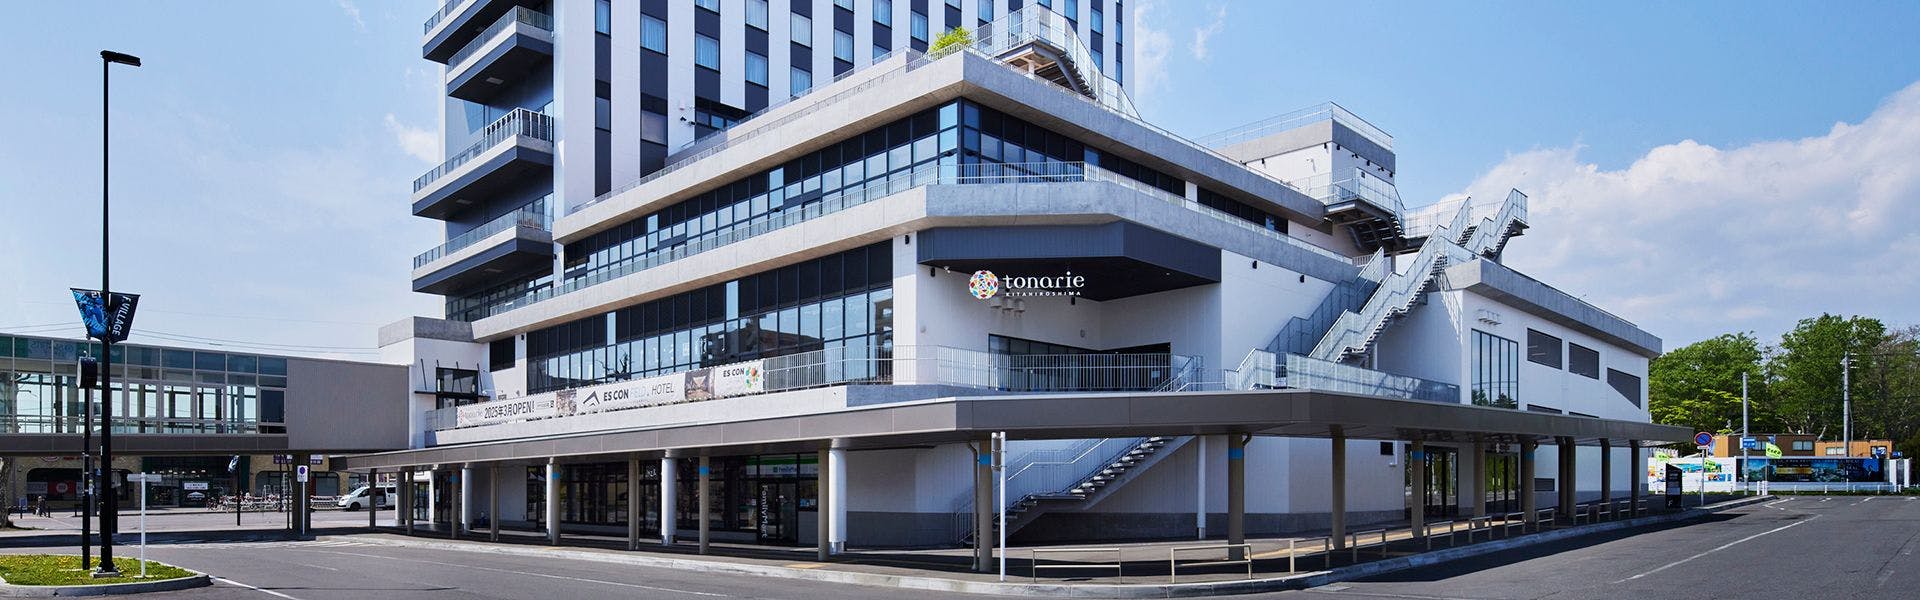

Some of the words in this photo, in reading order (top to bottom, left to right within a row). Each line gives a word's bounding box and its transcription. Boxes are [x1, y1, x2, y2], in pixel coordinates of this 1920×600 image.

[1002, 271, 1085, 289] tonarie
[112, 303, 131, 336] VILLAGE
[603, 392, 612, 402] ES
[613, 389, 629, 400] CON
[651, 382, 675, 396] HOTEL
